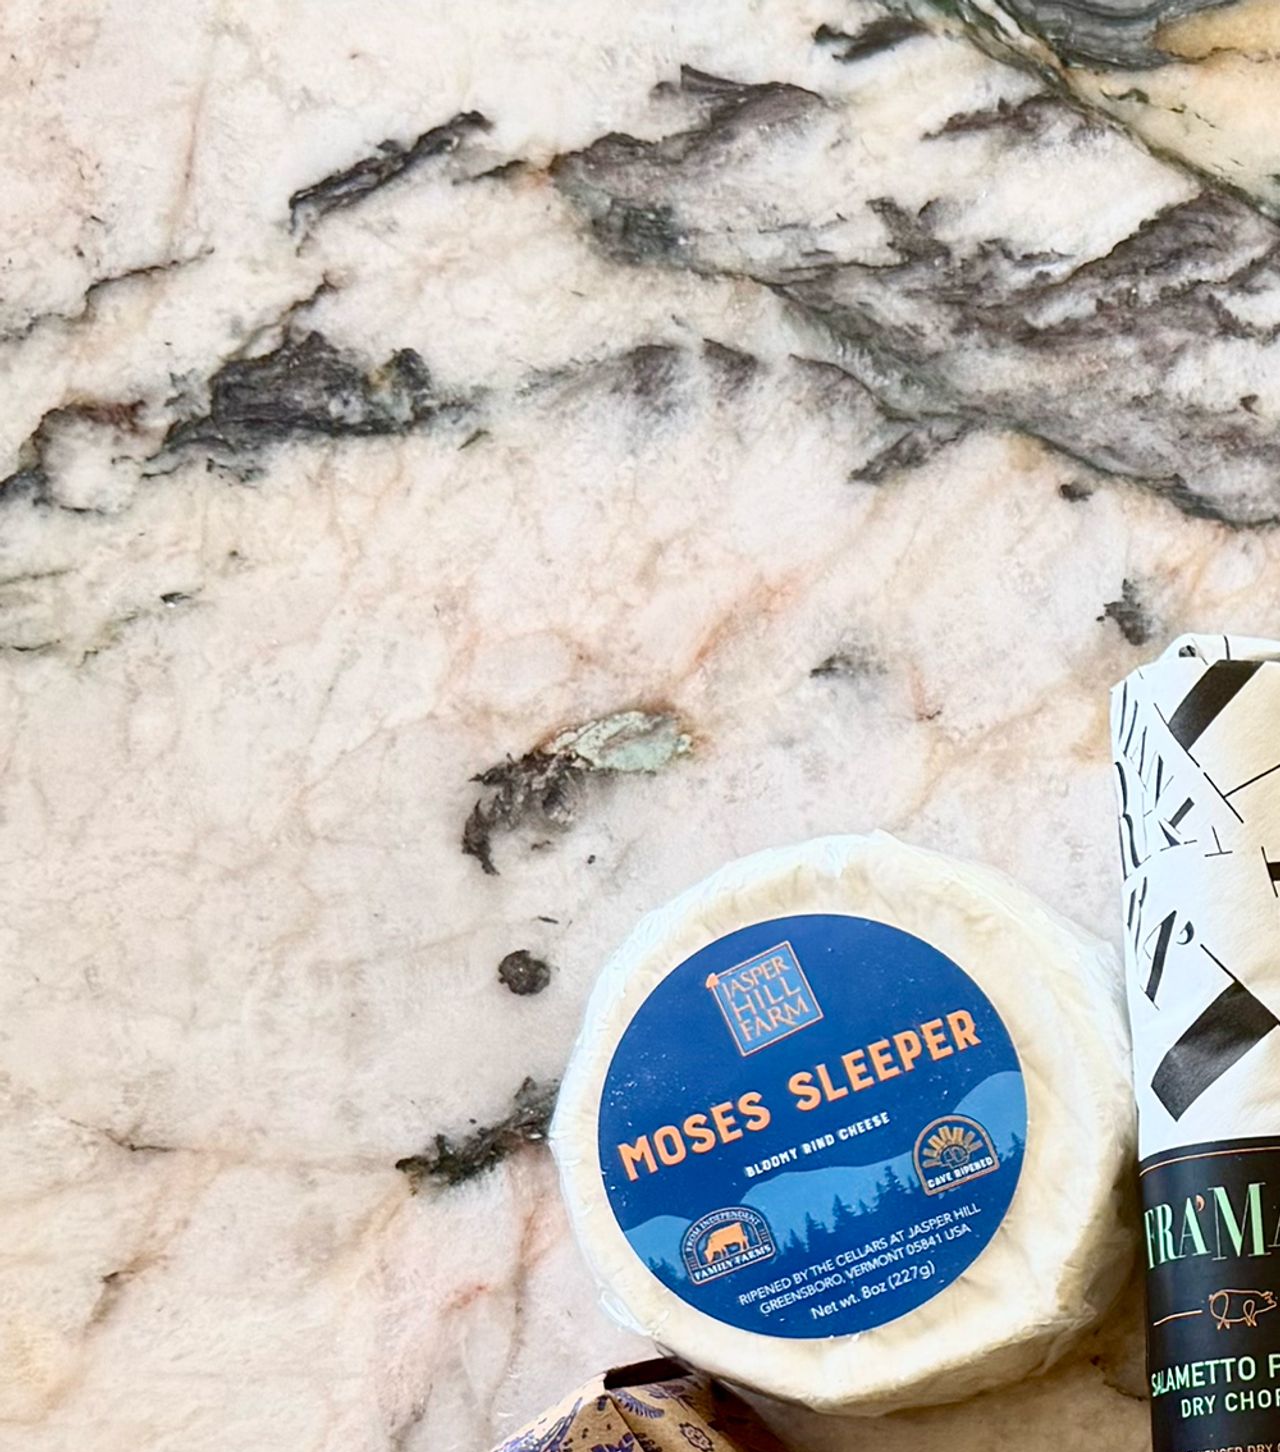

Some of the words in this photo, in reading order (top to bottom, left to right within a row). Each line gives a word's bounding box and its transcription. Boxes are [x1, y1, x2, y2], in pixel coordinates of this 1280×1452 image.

[721, 955, 790, 1001] JASPER
[729, 976, 801, 1022] HILL
[738, 993, 810, 1042] FARM
[617, 1091, 771, 1181] MOSES
[787, 1009, 982, 1111] SLEEPER
[744, 1147, 798, 1178] BLOOMY
[801, 1133, 835, 1155] RIND
[837, 1111, 890, 1141] CHEESE
[738, 1277, 792, 1306] RIPENED
[791, 1268, 808, 1285] BY
[808, 1258, 836, 1277] THE
[834, 1236, 889, 1267] CELLARS
[889, 1229, 905, 1246] AT
[907, 1212, 953, 1239] JASPER
[952, 1202, 982, 1220] HILL
[759, 1272, 846, 1315] GREENSBORO,
[844, 1246, 905, 1279] VERMONT
[905, 1232, 943, 1256] 05841
[943, 1223, 972, 1241] USA
[810, 1299, 846, 1320] Net
[844, 1290, 861, 1305] wt.
[860, 1281, 888, 1300] 8oz
[887, 1259, 936, 1290] (227g)
[1149, 1356, 1257, 1396] SALAMETTO
[1180, 1395, 1217, 1418] DRY
